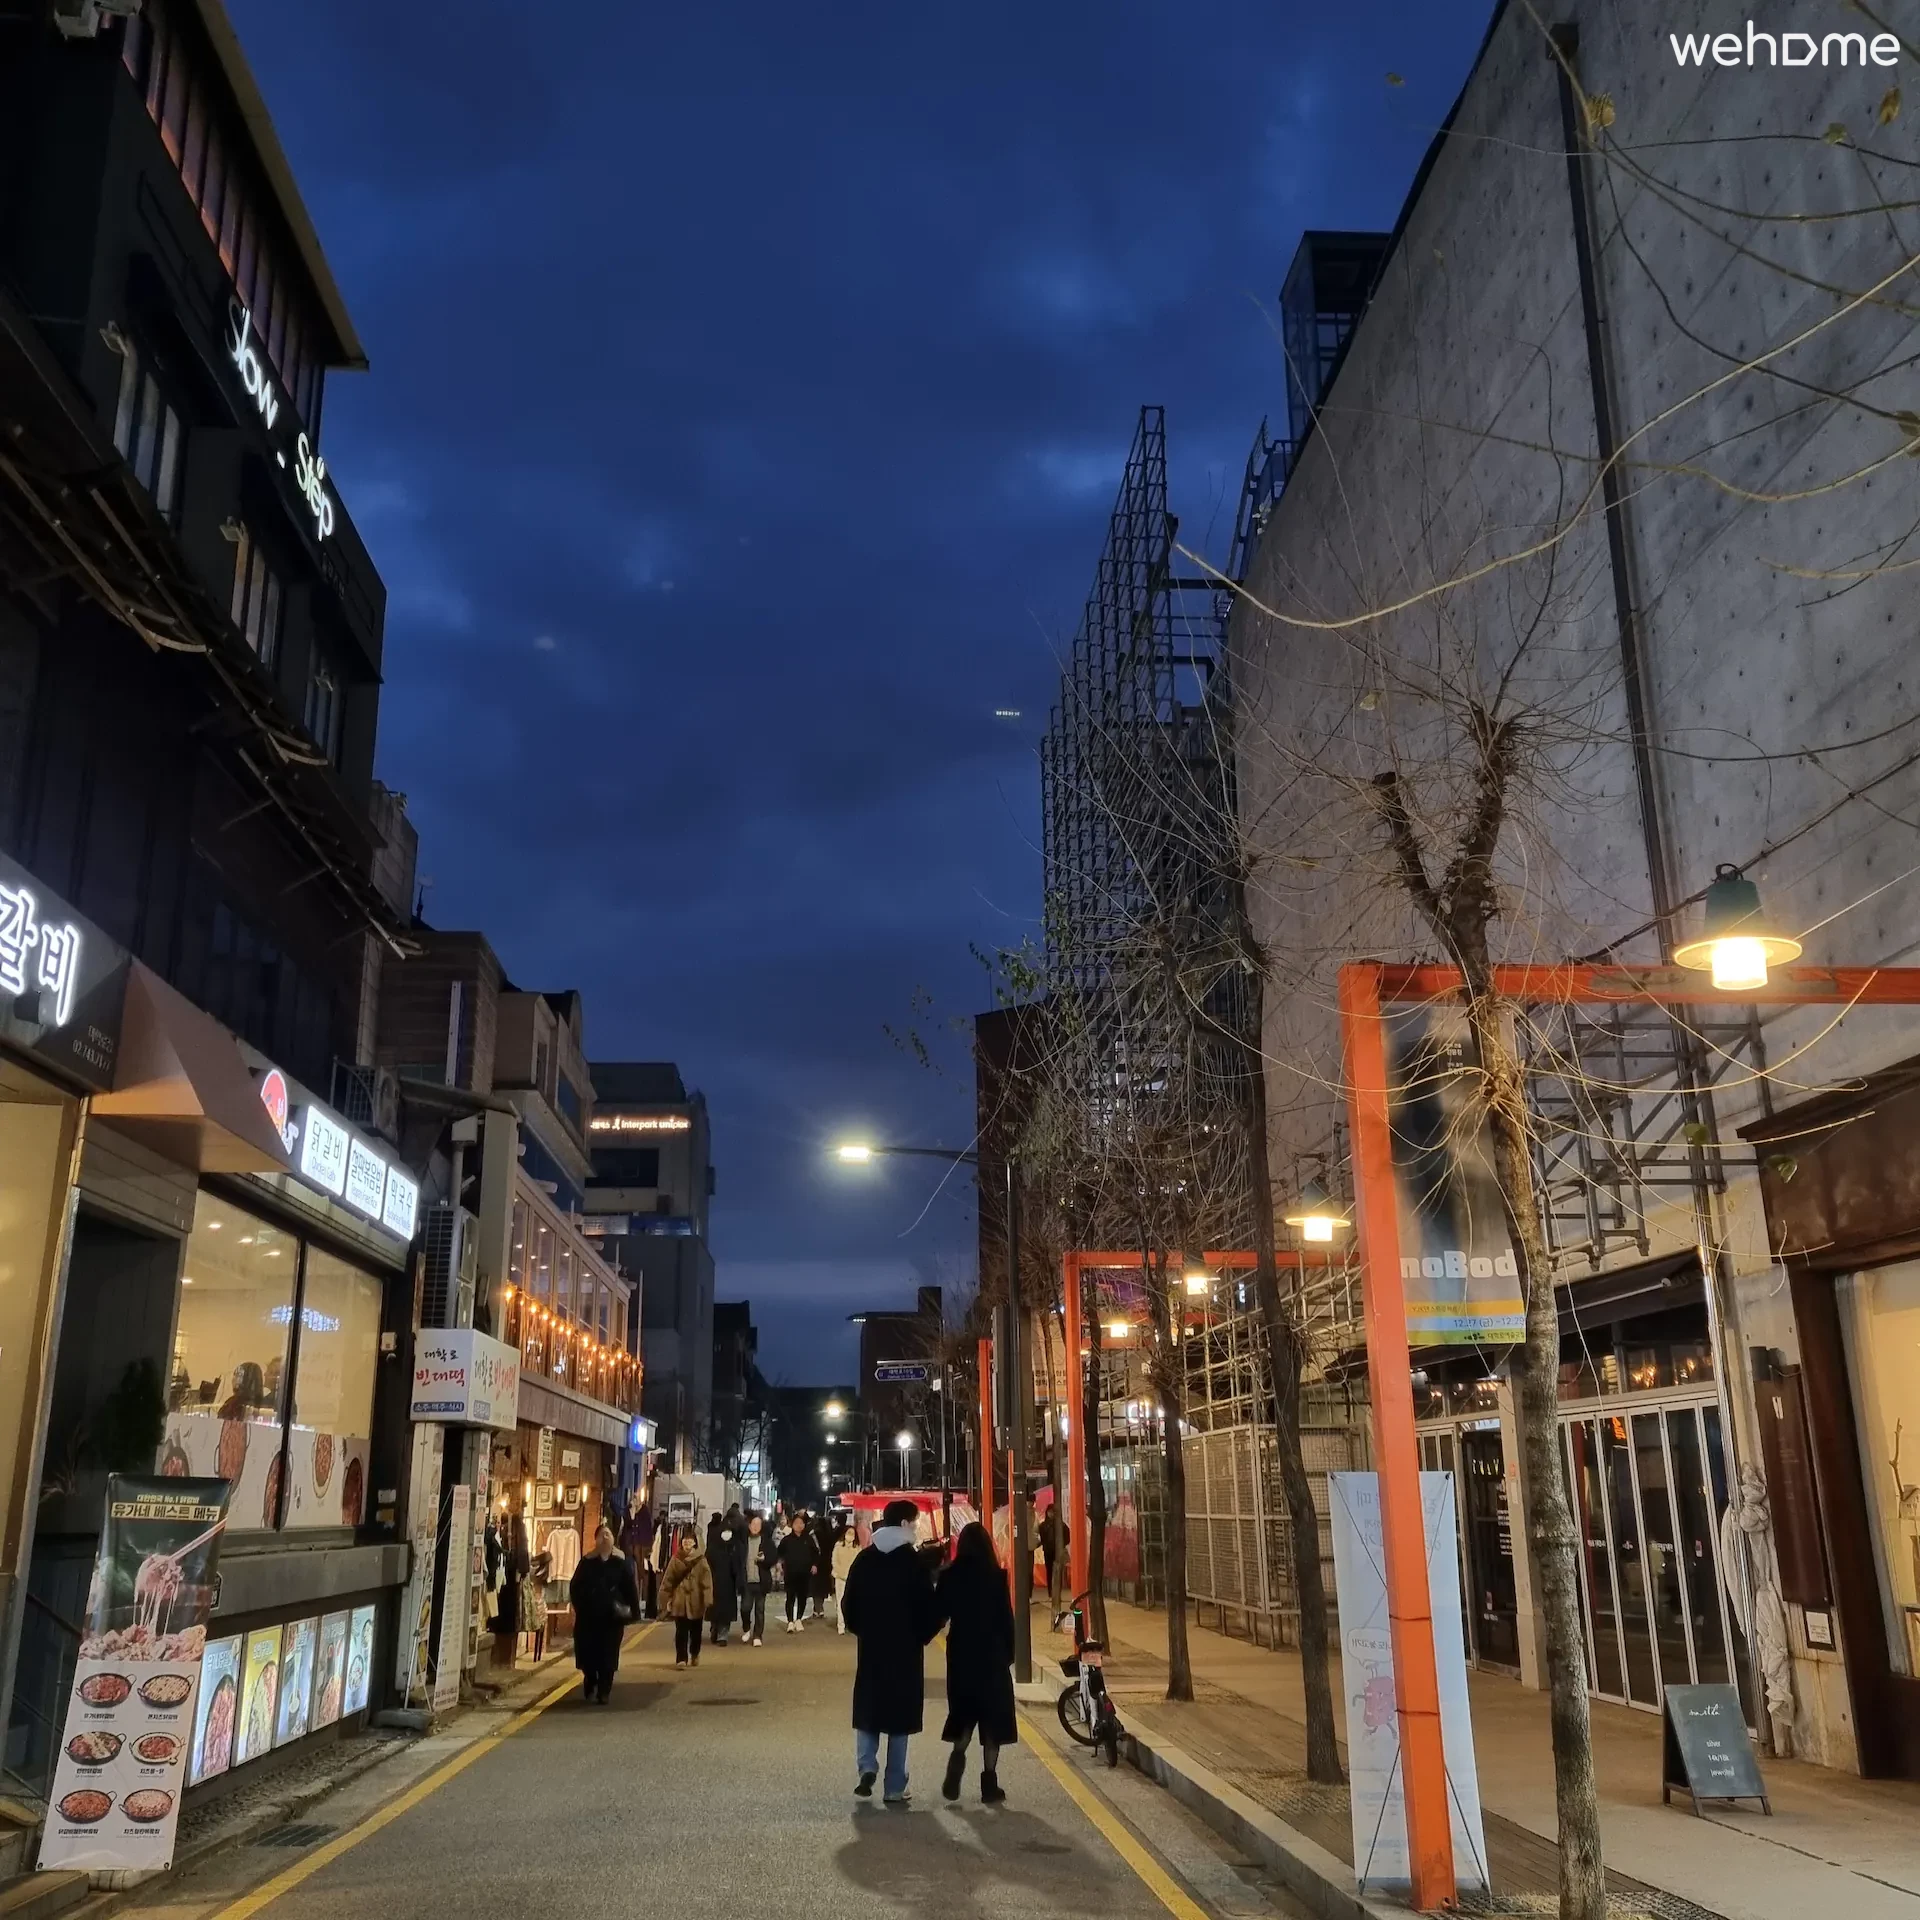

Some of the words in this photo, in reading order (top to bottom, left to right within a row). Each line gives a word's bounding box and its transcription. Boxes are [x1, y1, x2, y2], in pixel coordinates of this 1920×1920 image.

[312, 1120, 345, 1168] 닭갈비
[351, 1149, 383, 1195] 철판볶음밥
[391, 1179, 413, 1216] 막국수
[423, 1347, 460, 1363] 대학로
[415, 1367, 466, 1388] 빈대떡
[113, 1503, 151, 1517] 유가네
[154, 1505, 190, 1519] 베스트
[193, 1506, 218, 1520] 메뉴
